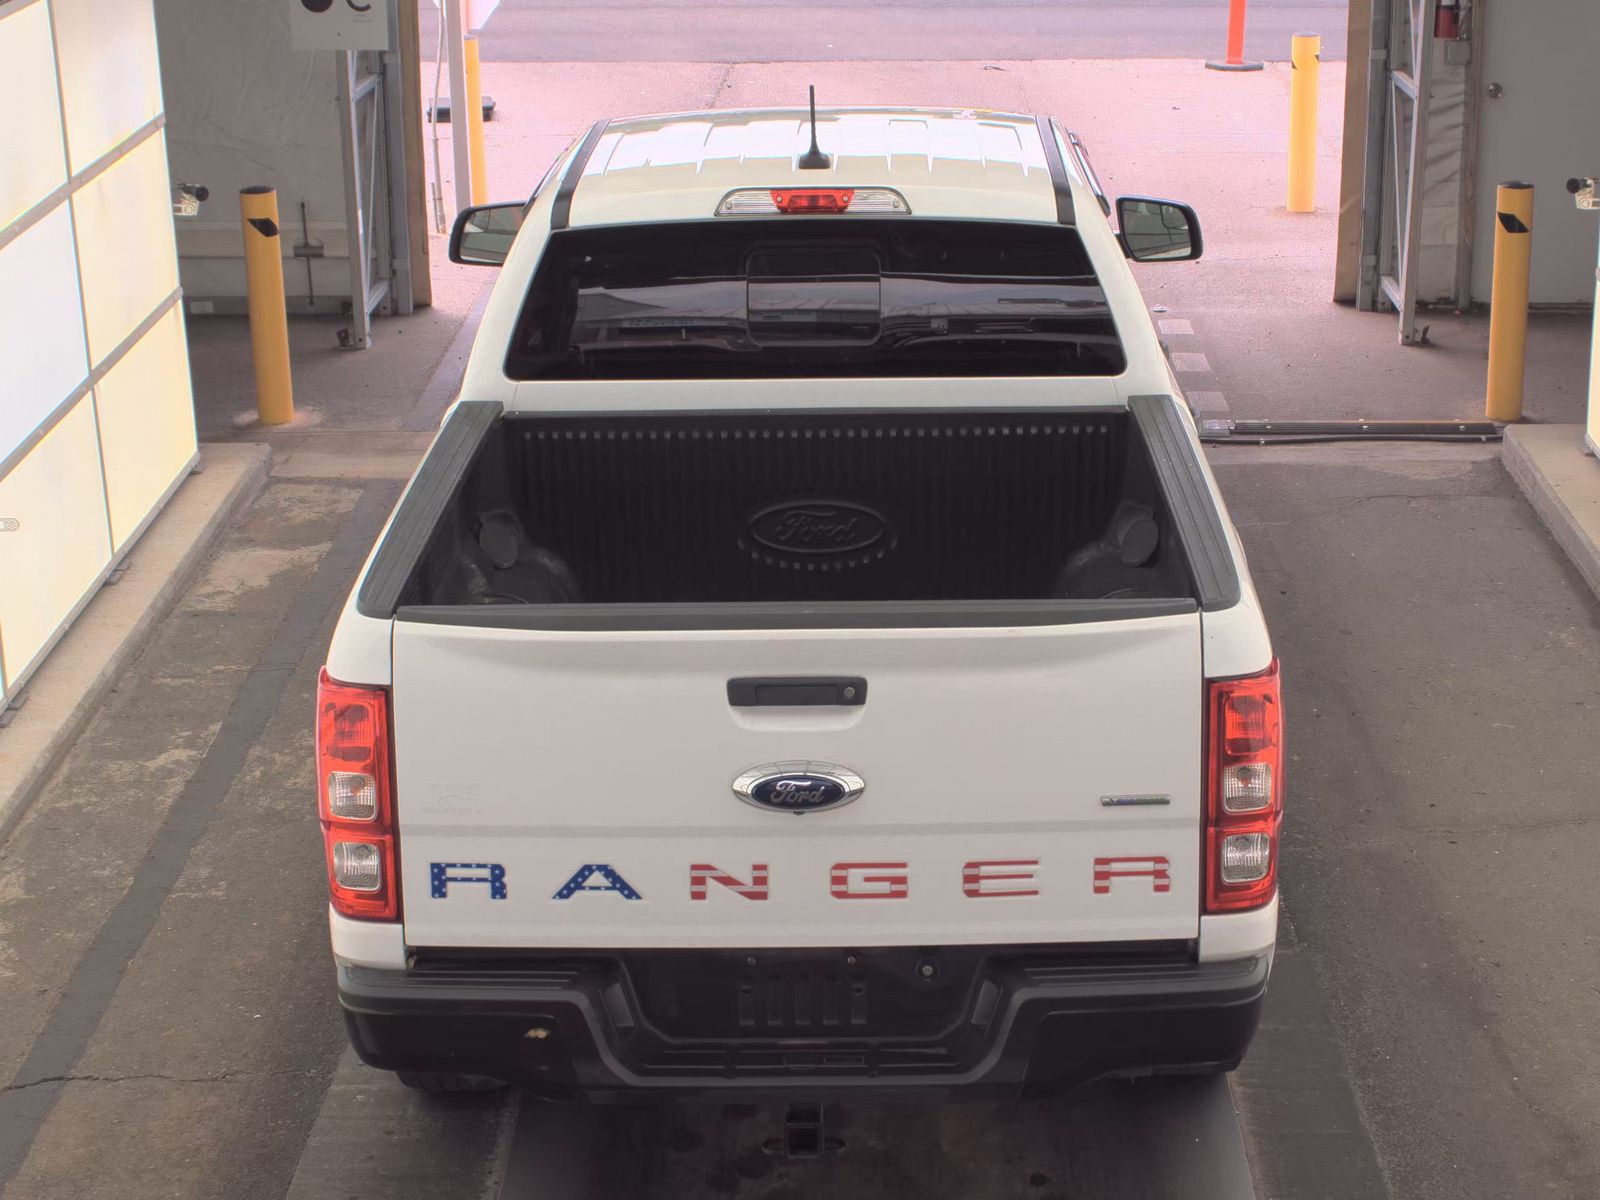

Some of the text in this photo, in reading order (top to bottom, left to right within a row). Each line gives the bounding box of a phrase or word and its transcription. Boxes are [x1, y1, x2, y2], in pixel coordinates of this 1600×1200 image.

[774, 510, 857, 541] Ford
[770, 780, 825, 804] Ford
[430, 856, 1170, 900] RANGER
